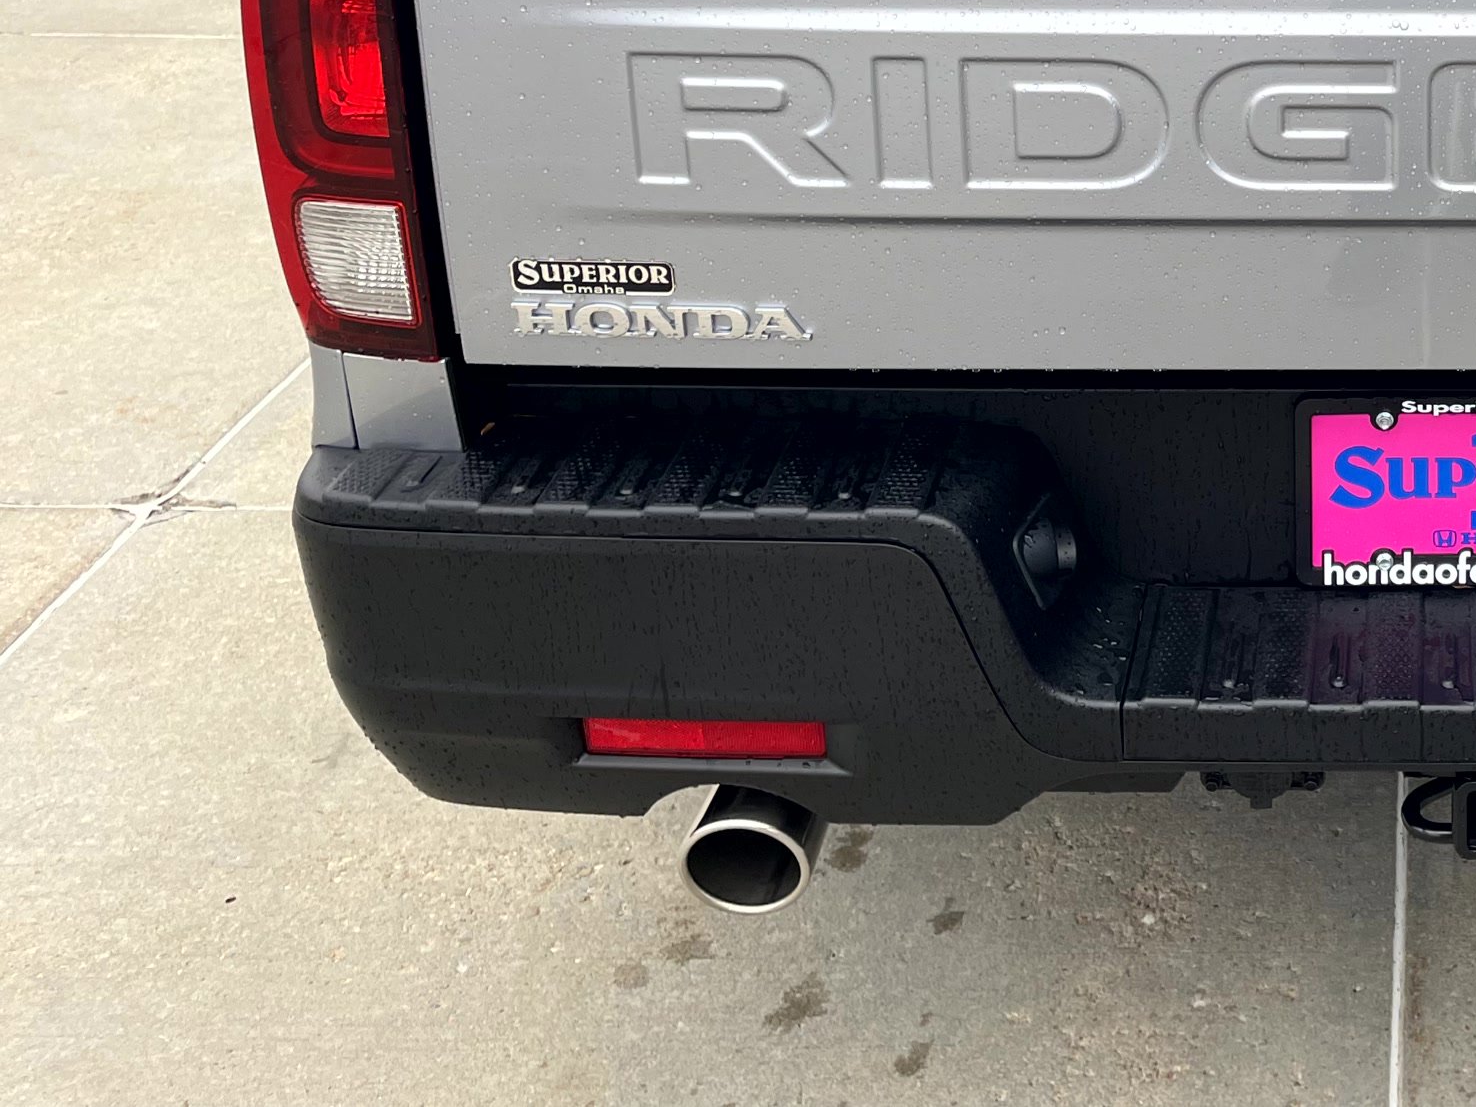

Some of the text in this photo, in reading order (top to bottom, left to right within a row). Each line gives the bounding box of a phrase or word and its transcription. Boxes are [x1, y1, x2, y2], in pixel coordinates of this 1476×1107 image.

[517, 260, 670, 285] SUPERIOR
[563, 284, 626, 295] Omaha
[511, 300, 813, 342] HONDA
